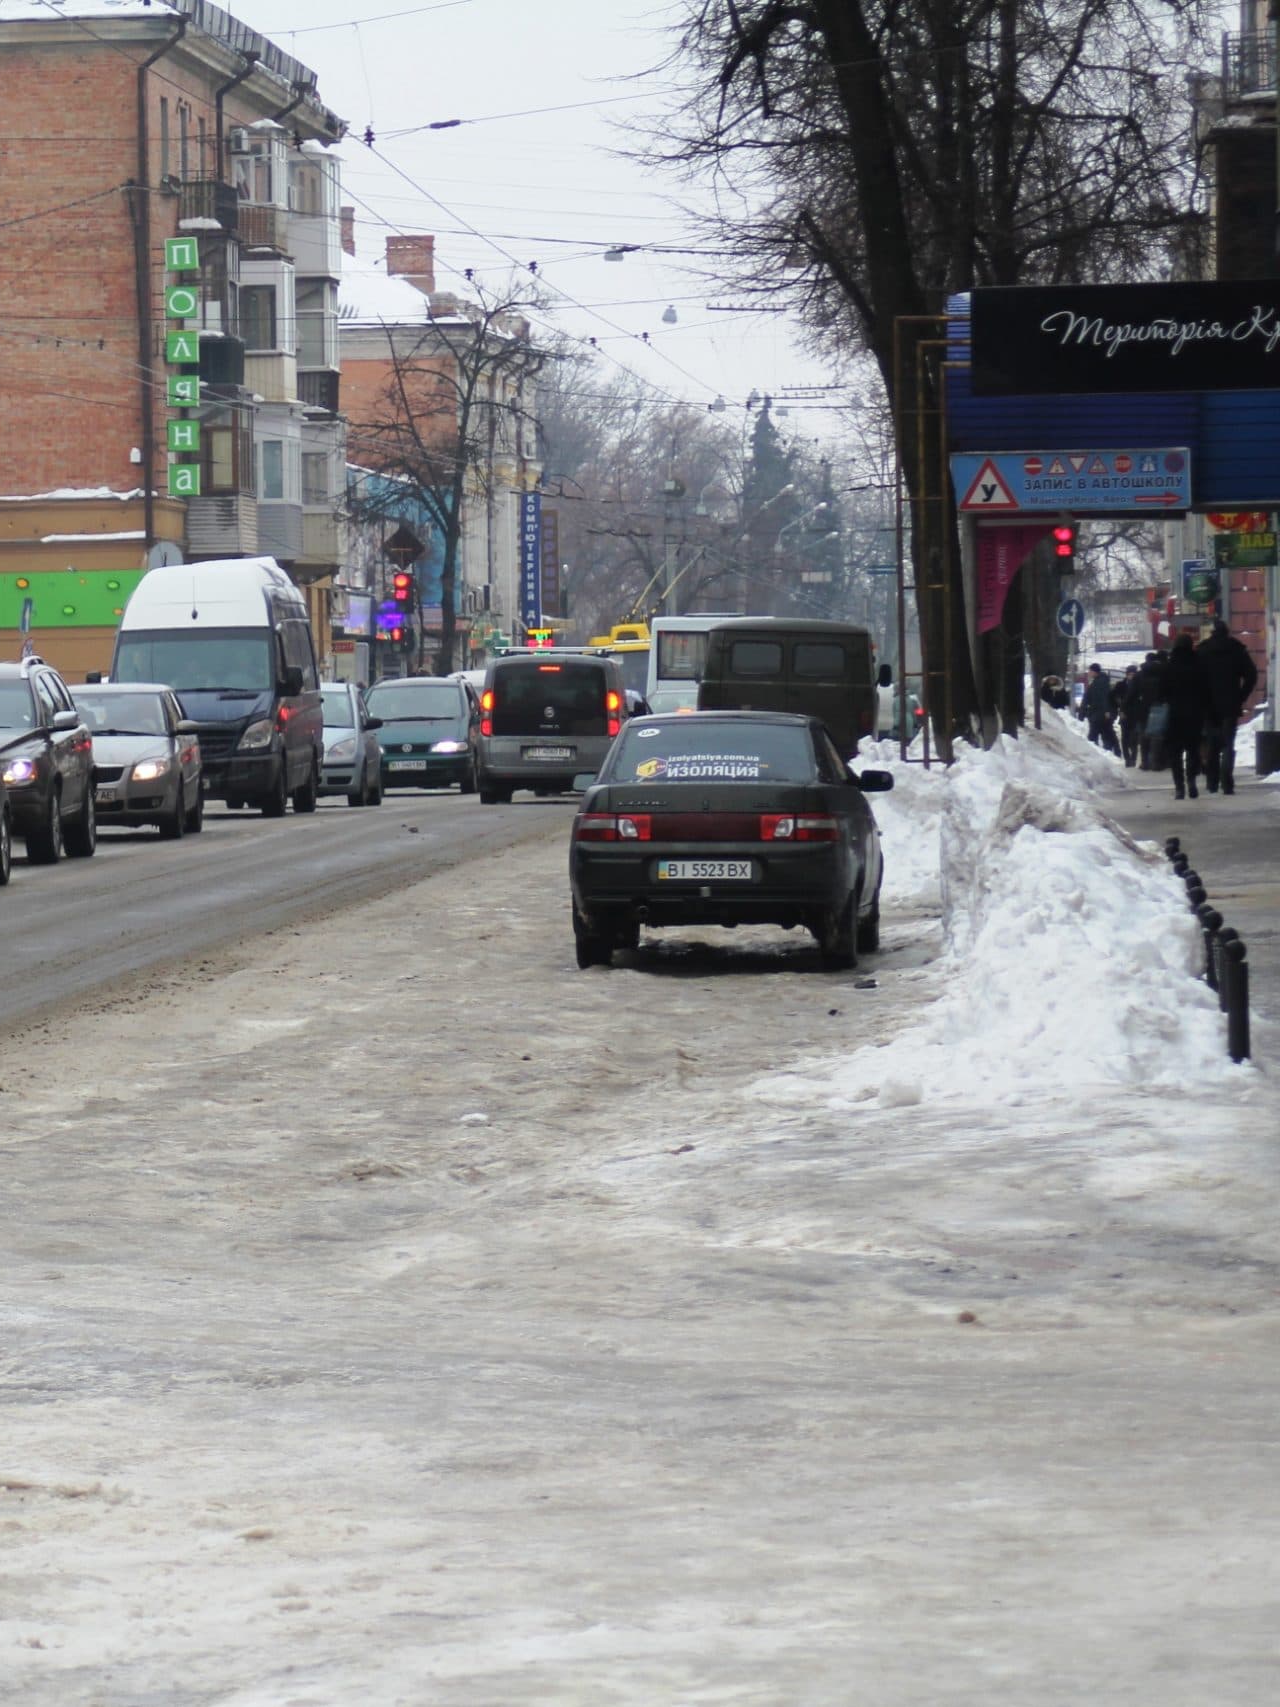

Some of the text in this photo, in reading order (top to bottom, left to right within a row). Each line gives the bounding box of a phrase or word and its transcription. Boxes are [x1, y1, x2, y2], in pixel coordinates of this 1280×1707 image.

[1024, 475, 1185, 491] ЗАПИС В АВТОШКОЛУ
[667, 765, 759, 778] ИЗОЛЯЦИЯ
[692, 863, 724, 877] 5523
[727, 863, 749, 877] BX
